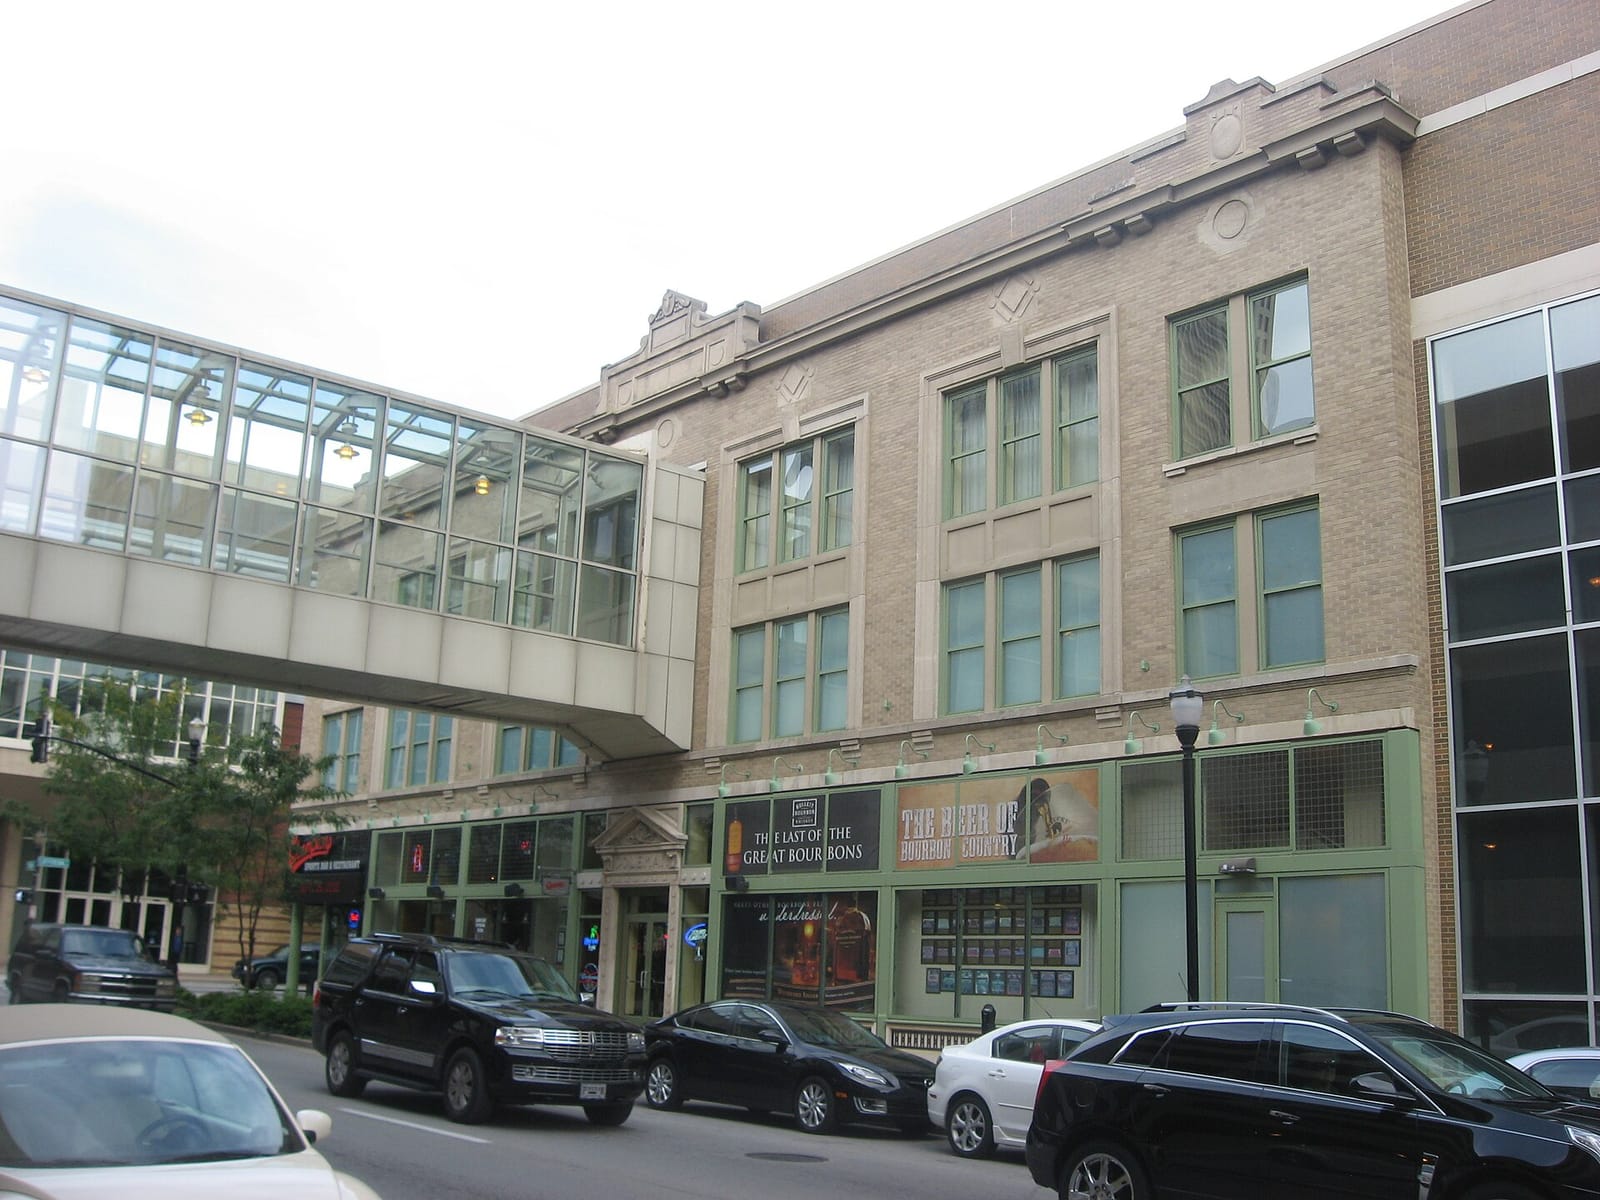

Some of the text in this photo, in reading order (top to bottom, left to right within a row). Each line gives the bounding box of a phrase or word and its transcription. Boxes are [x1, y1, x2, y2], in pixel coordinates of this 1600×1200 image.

[902, 801, 1019, 840] THE BEER OF
[755, 827, 852, 845] THE LAST OF THE
[901, 834, 1018, 862] BOURBON COUNTRY
[743, 844, 863, 865] GREAT BOURBONS
